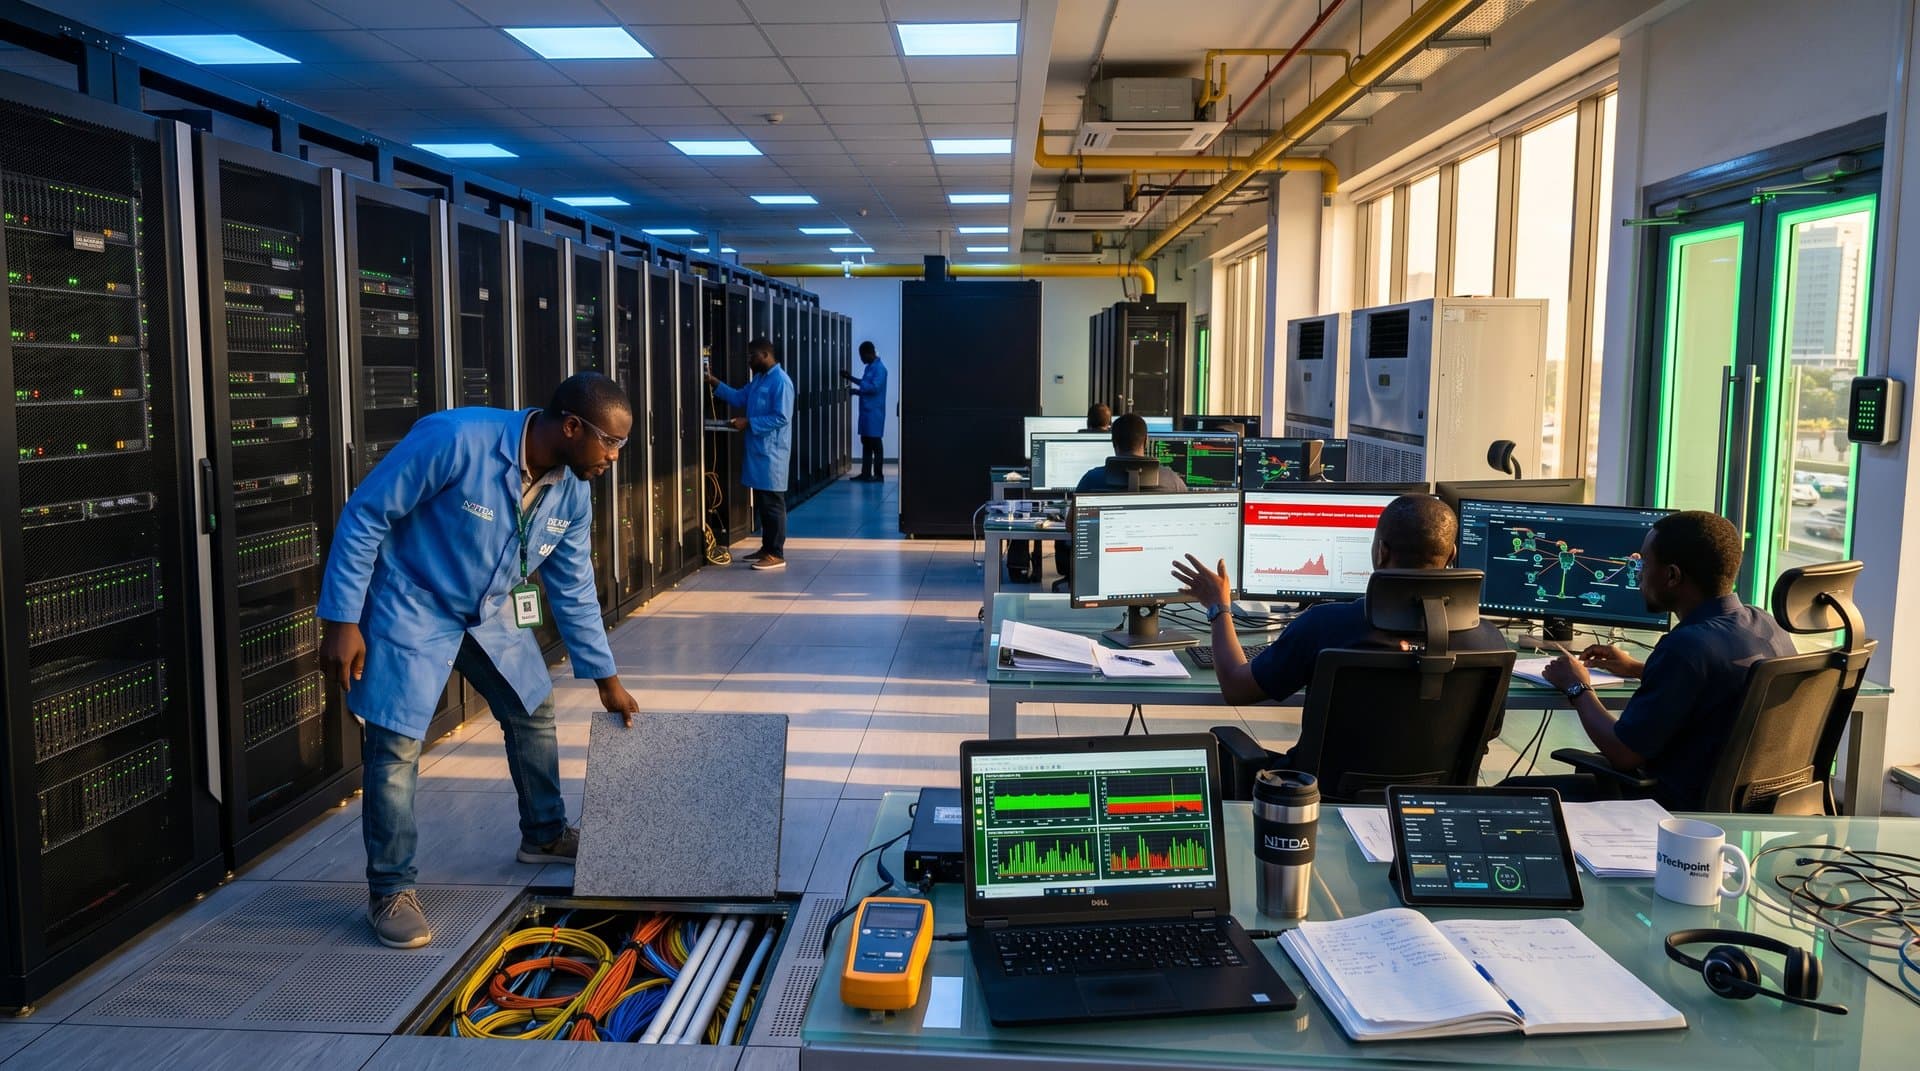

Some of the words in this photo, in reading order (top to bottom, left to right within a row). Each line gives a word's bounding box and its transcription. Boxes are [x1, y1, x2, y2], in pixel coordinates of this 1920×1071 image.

[1264, 834, 1310, 848] NITDA
[1662, 854, 1710, 872] Techpoint
[1091, 899, 1110, 907] DELL
